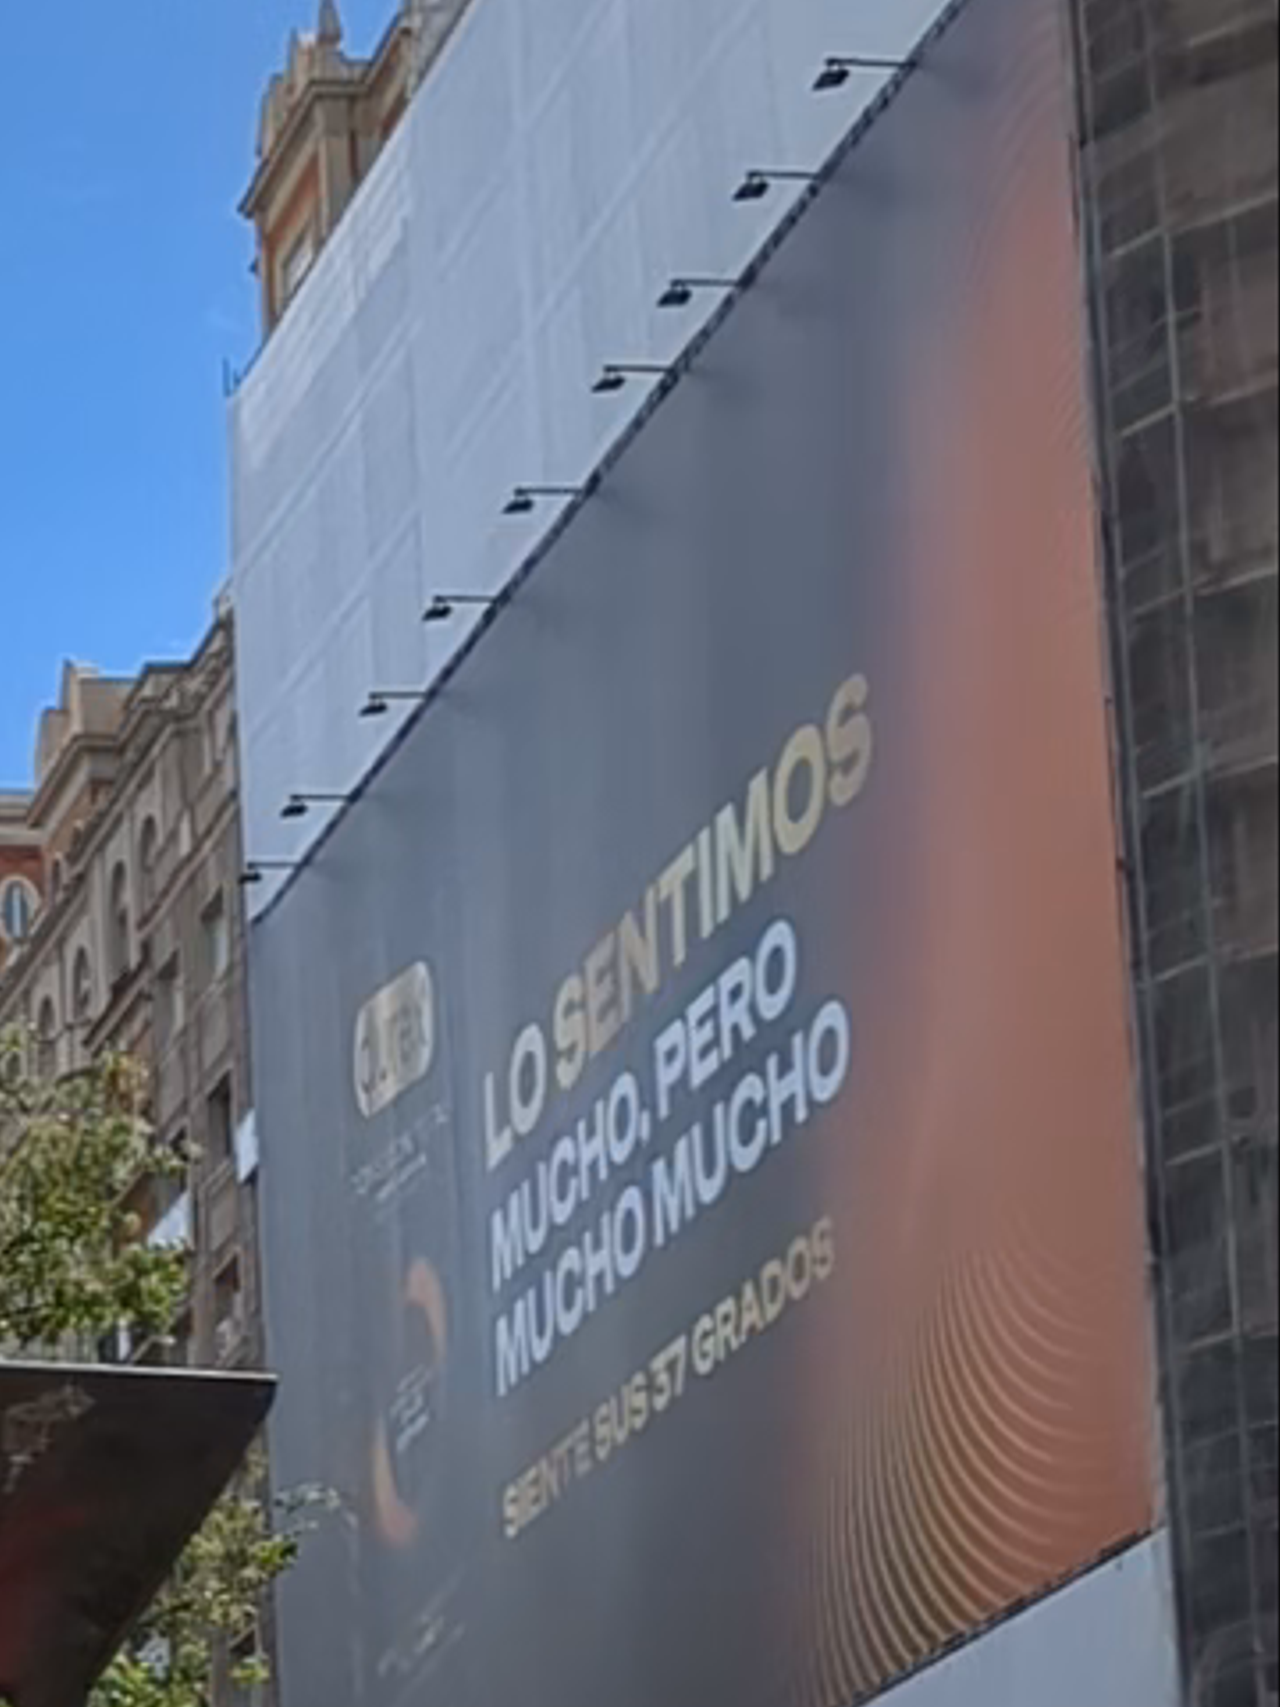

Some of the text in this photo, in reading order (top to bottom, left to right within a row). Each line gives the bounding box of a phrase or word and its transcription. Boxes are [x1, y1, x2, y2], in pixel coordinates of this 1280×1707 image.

[484, 673, 872, 1171] LO SENTIMOS
[492, 919, 797, 1291] MUCHO, PERO
[496, 1185, 645, 1396] MUCHO
[652, 1000, 850, 1247] MUCHO
[503, 1216, 835, 1539] SIENTE SUS 37 GRADOS
